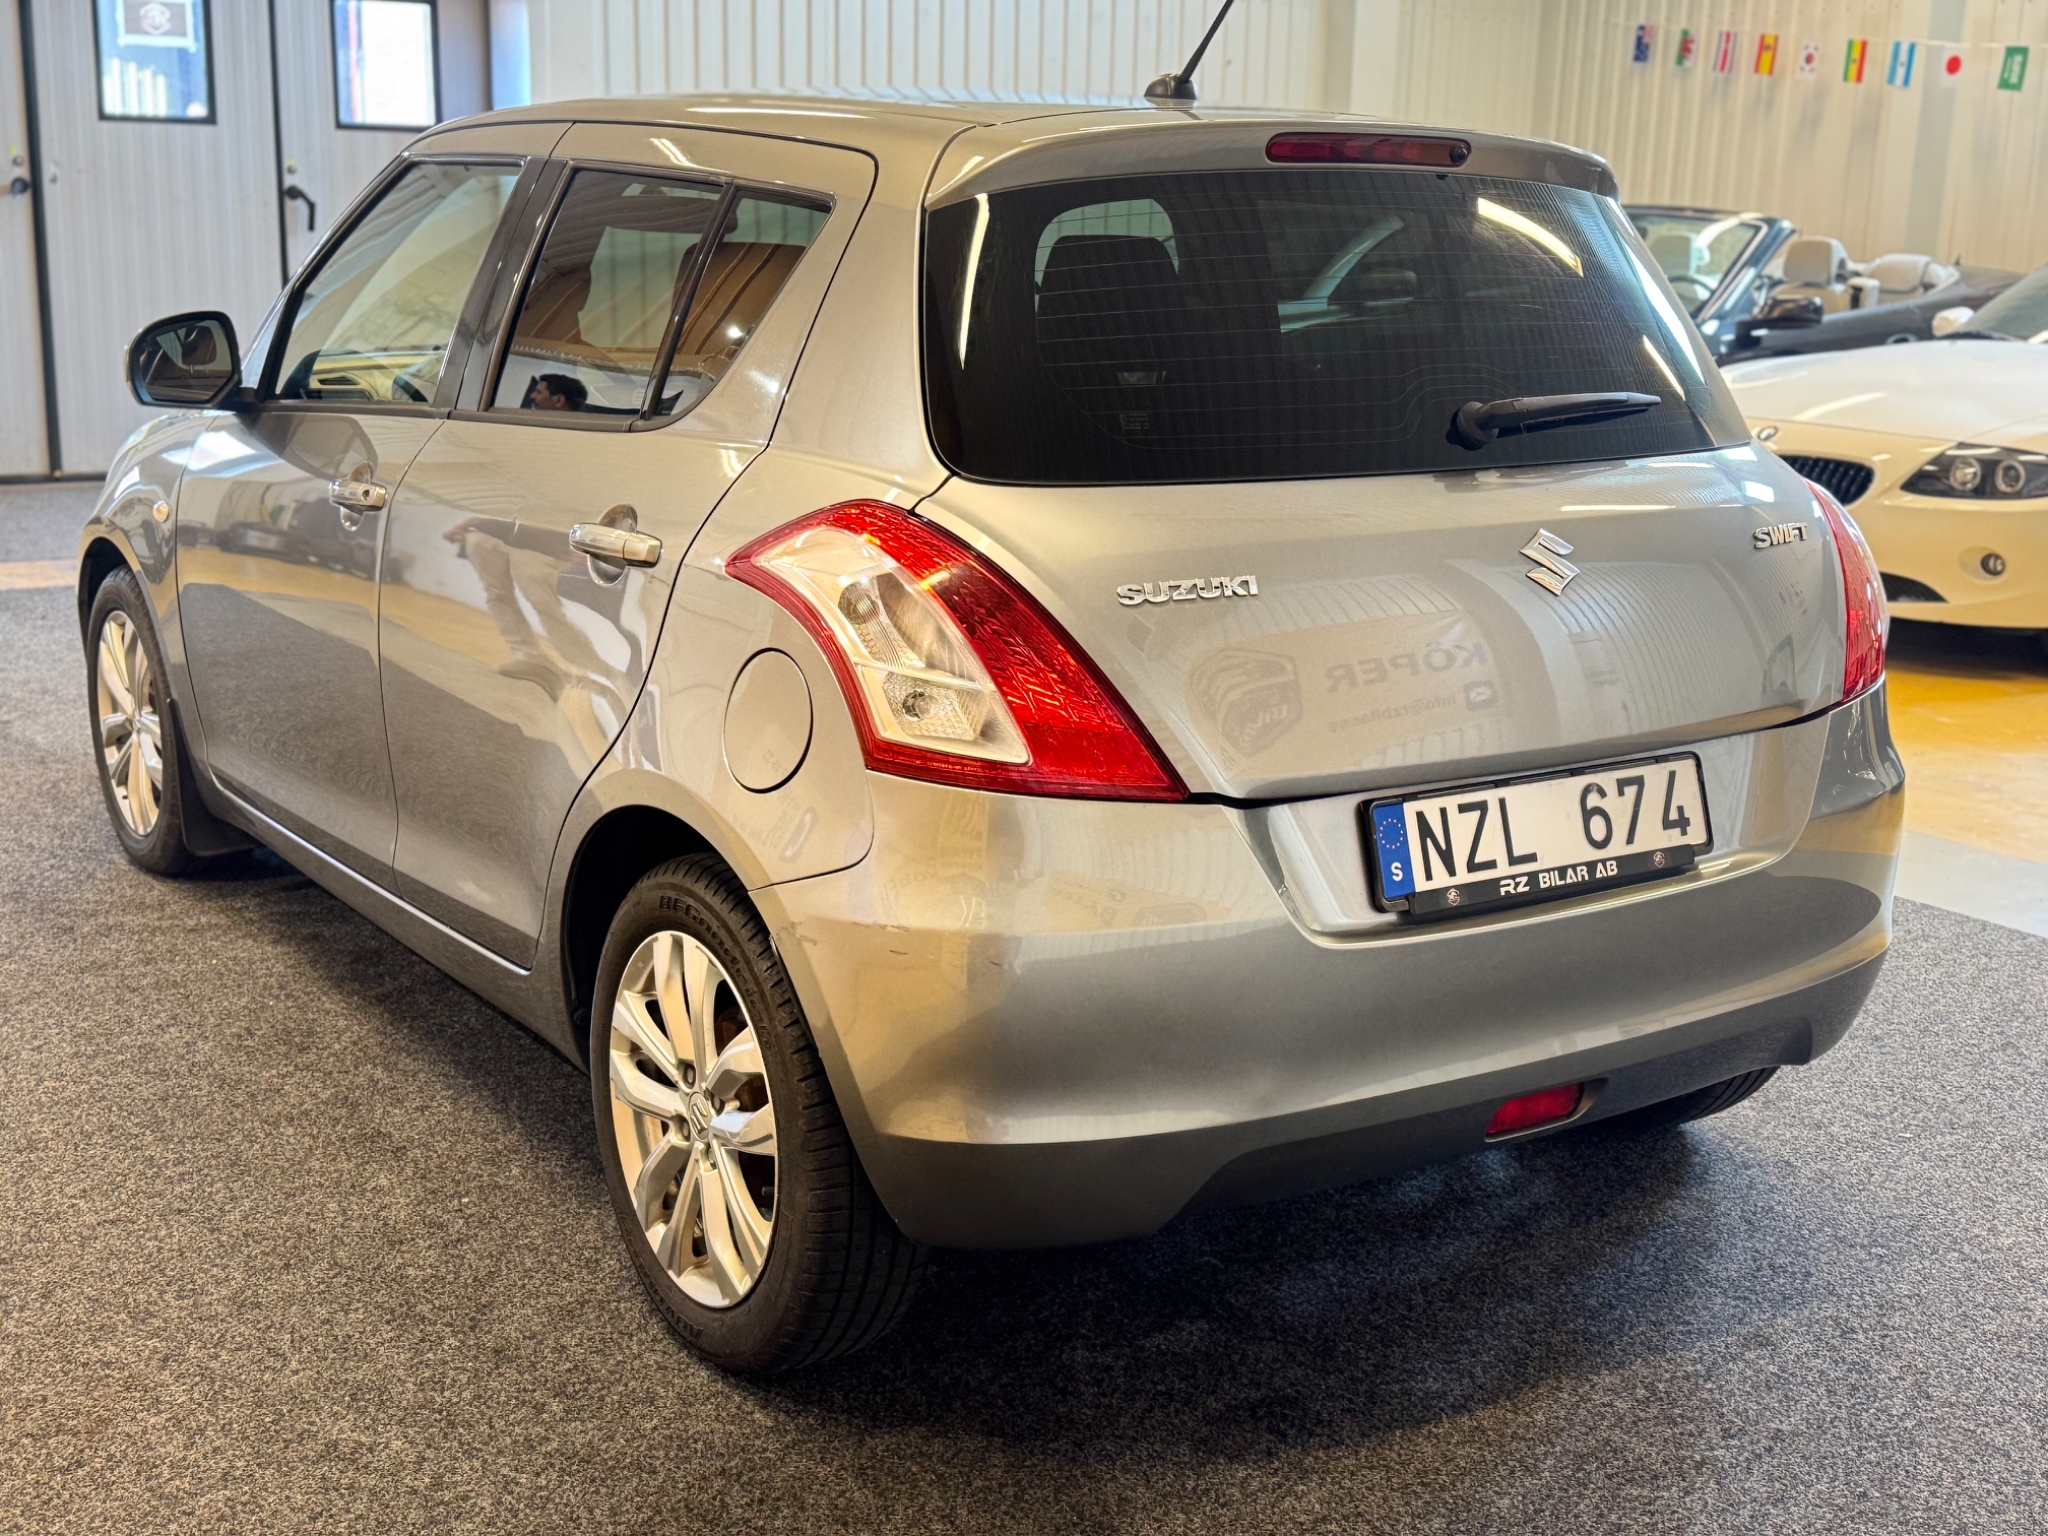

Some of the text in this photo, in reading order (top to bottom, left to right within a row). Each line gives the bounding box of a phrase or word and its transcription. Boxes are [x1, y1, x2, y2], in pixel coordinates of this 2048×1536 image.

[1753, 522, 1808, 550] SWIFT
[1116, 575, 1259, 606] SUZUKI
[1415, 769, 1692, 881] NZL 674
[1391, 861, 1404, 882] S
[1500, 860, 1619, 896] RZ BILAR AB
